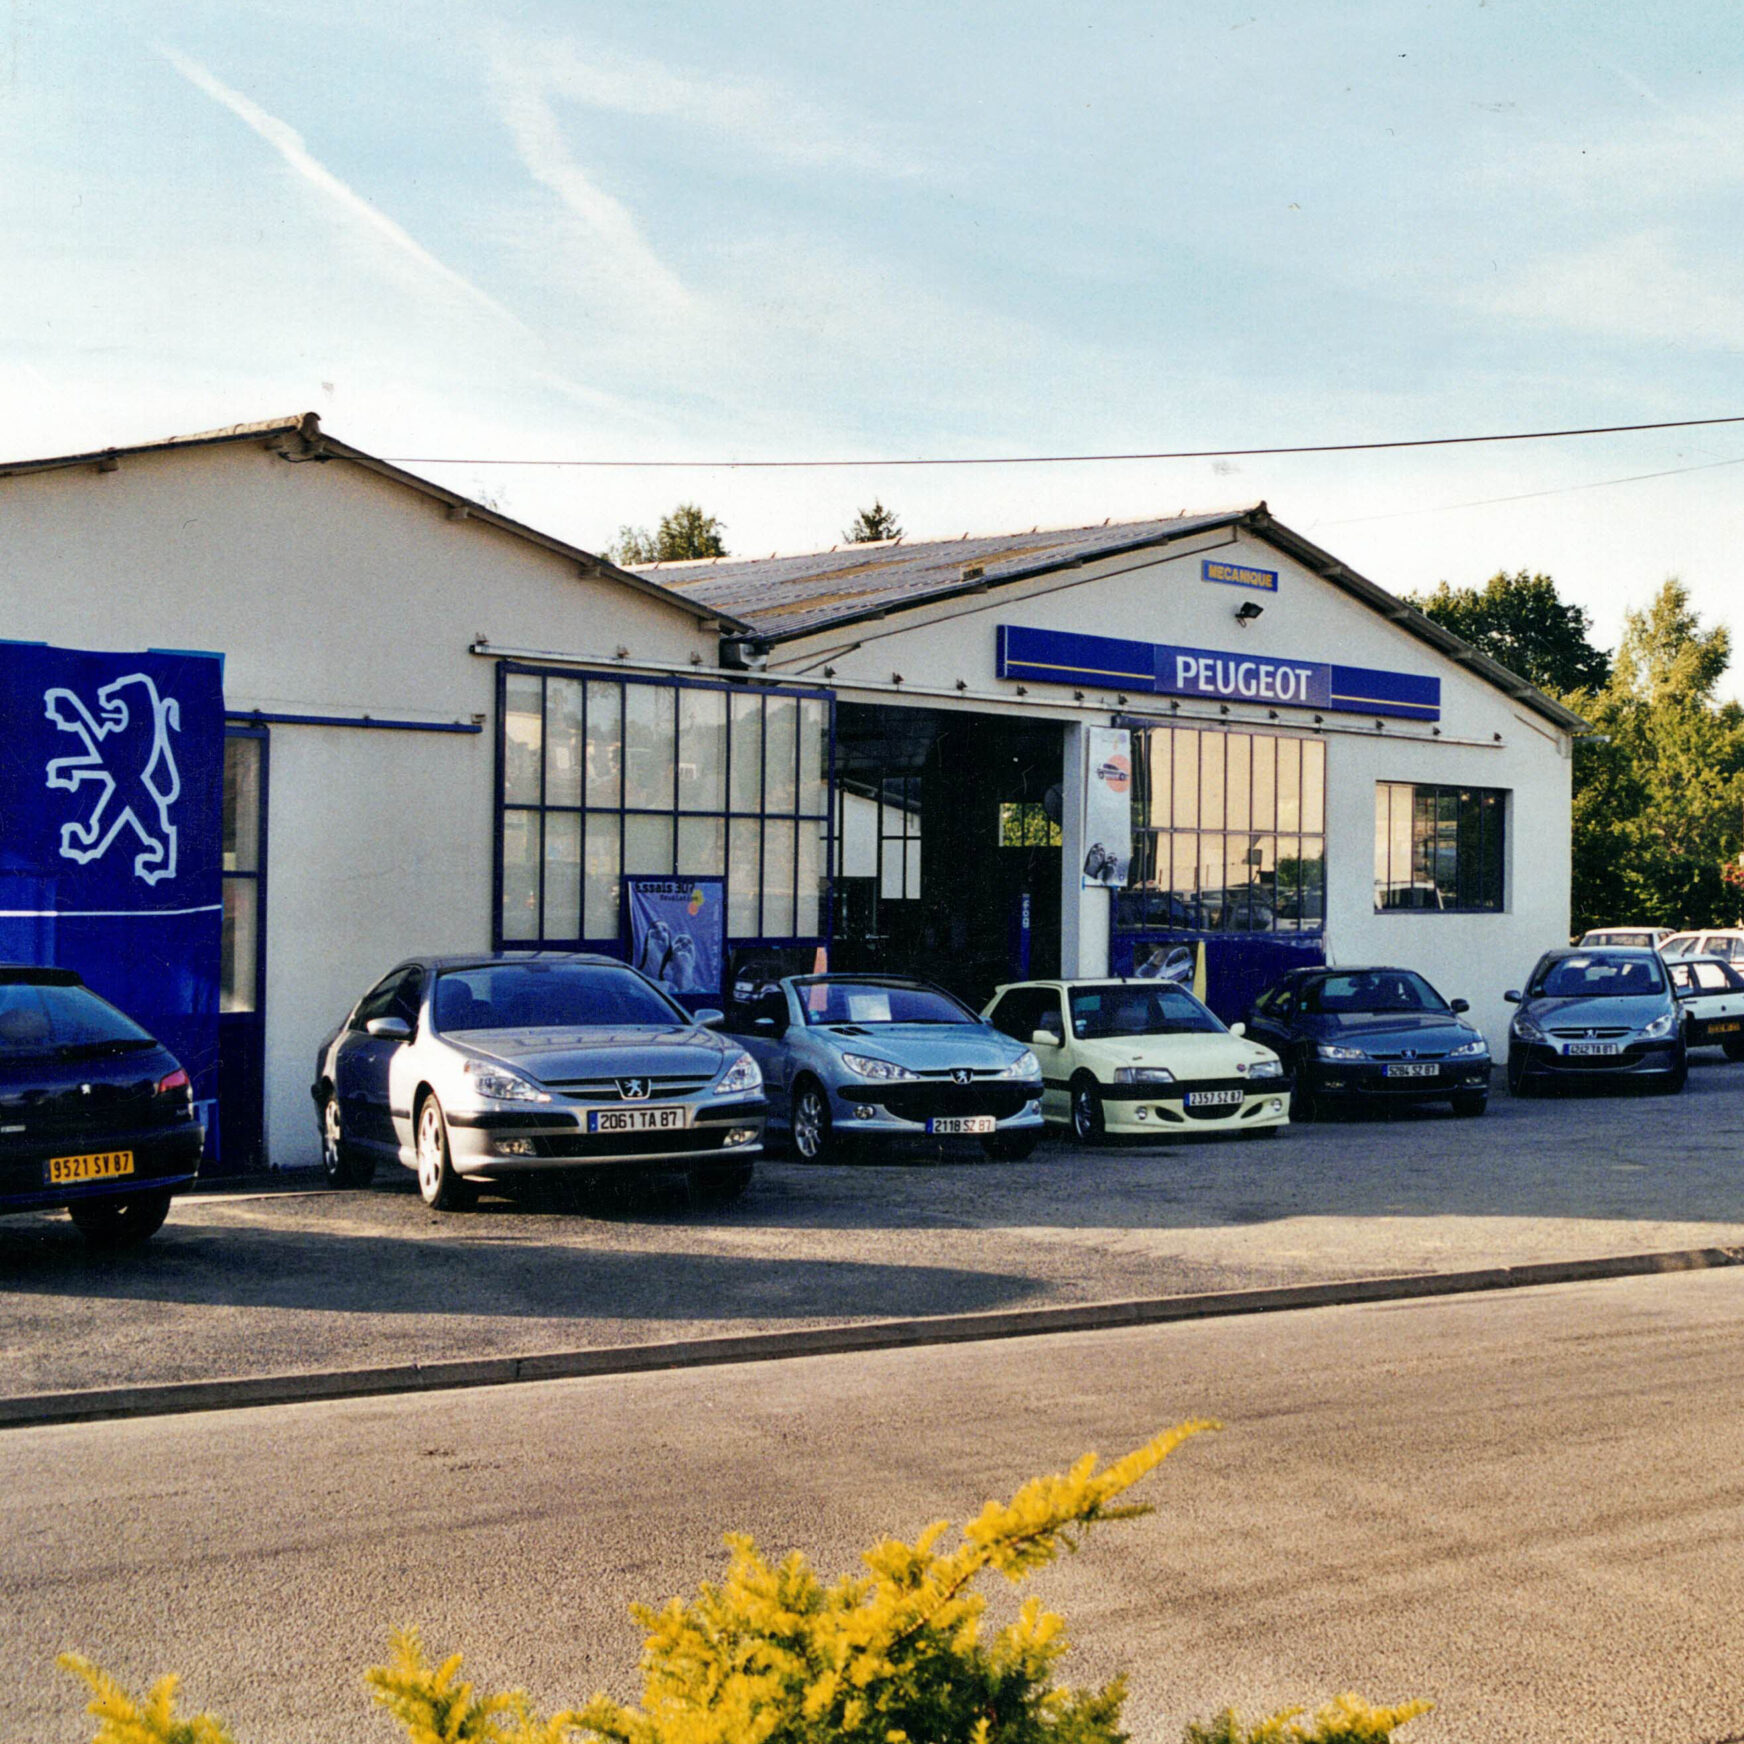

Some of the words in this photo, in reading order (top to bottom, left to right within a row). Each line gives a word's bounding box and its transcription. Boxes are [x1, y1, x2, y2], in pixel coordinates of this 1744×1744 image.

[1208, 564, 1273, 588] MECANIQUE
[1176, 655, 1312, 700] PEUGEOT
[1191, 1092, 1215, 1105] 2357
[1231, 1090, 1242, 1102] 87
[601, 1113, 635, 1129] 2061
[640, 1112, 657, 1127] TA
[660, 1111, 677, 1127] 87
[935, 1119, 961, 1132] 2118
[978, 1119, 992, 1132] 87
[53, 1158, 89, 1179] 9521
[94, 1155, 110, 1175] SV
[113, 1153, 129, 1172] 87
